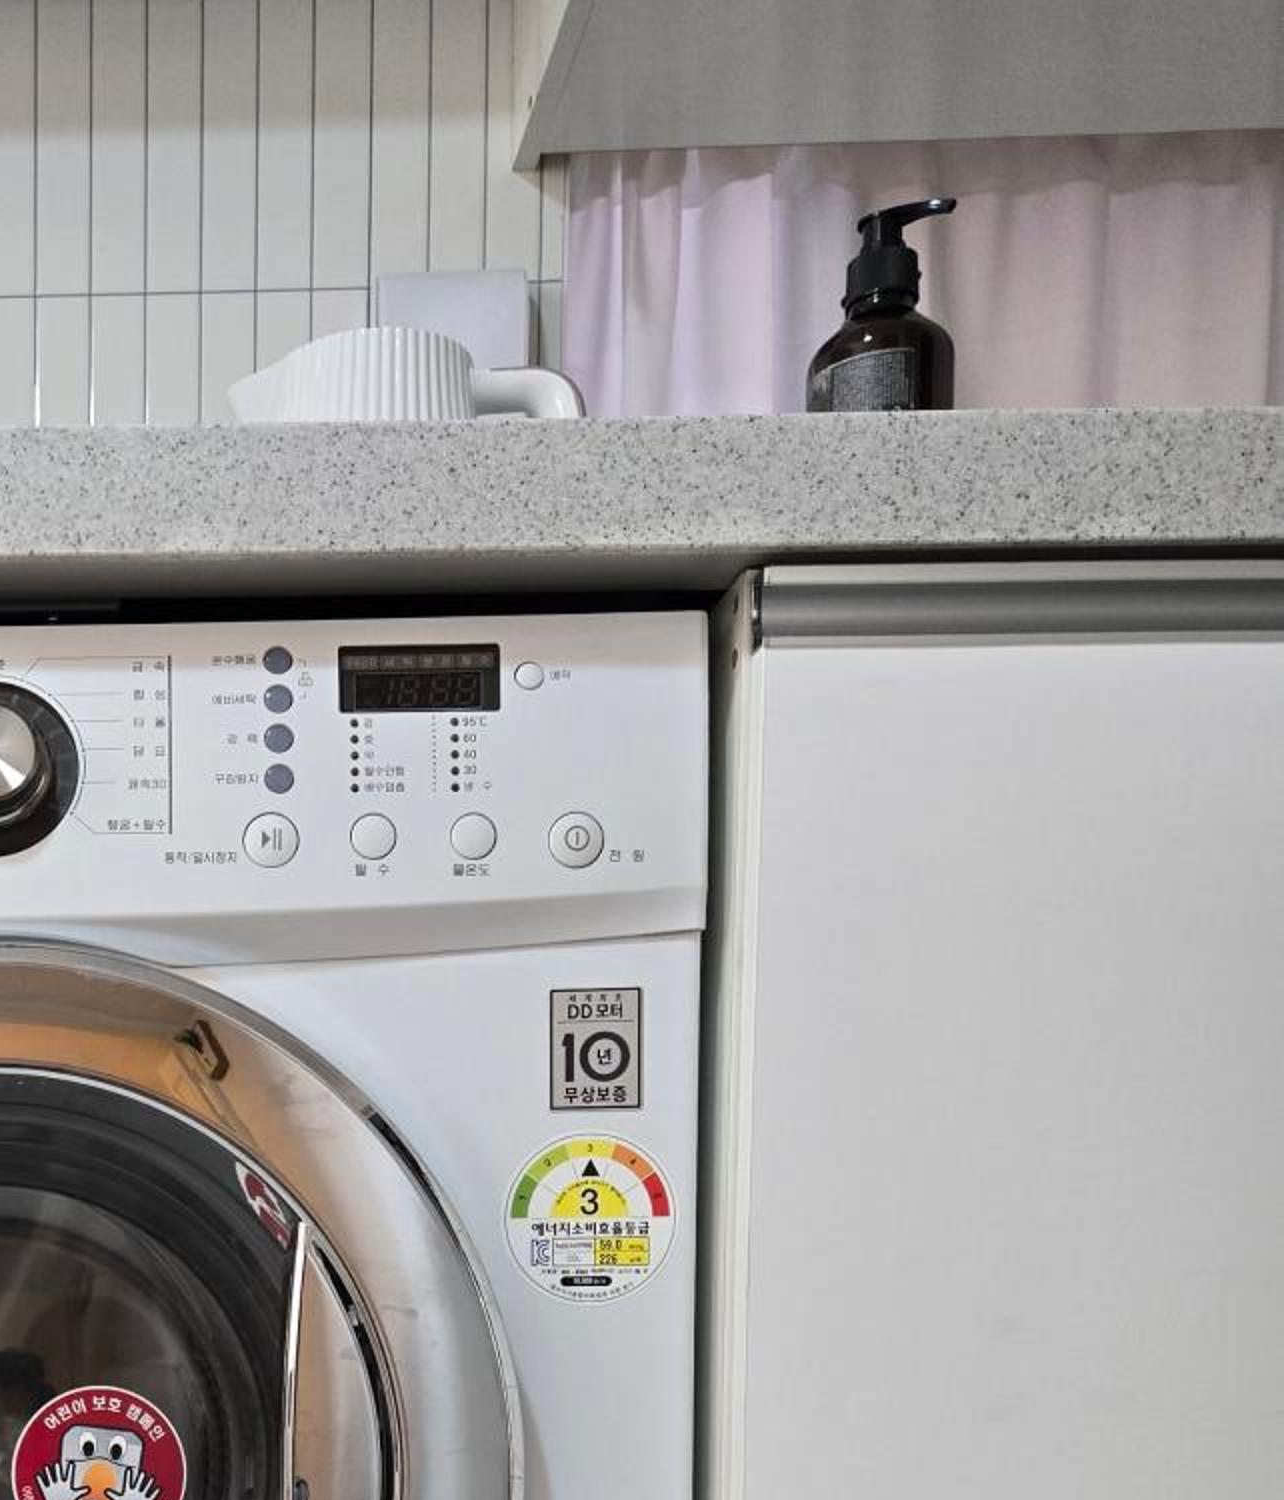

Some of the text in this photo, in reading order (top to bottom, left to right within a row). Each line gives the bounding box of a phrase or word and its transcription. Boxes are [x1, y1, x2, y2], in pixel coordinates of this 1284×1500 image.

[563, 1085, 627, 1104] 무상보증
[579, 1188, 599, 1215] 3
[531, 1221, 650, 1237] 에너지소비효율등급
[43, 1396, 165, 1442] 어린이 보호 캠페인
